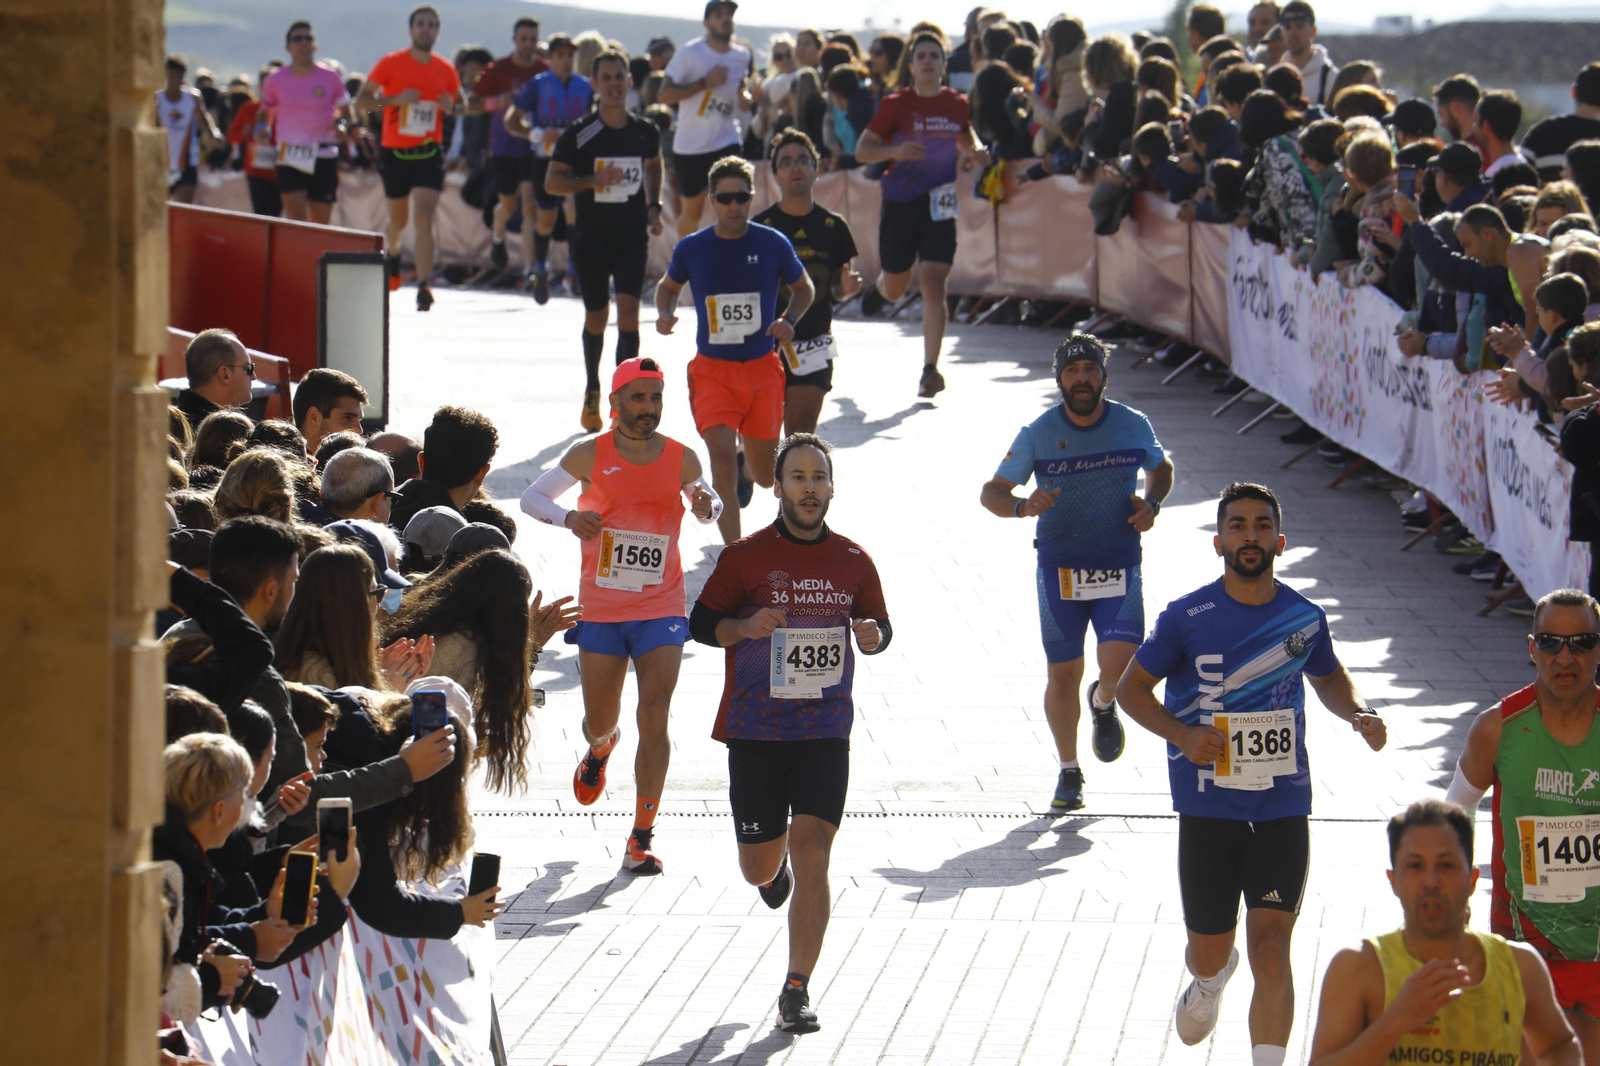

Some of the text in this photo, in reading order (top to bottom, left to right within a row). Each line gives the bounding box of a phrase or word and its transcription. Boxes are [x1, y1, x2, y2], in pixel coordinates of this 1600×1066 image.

[722, 304, 753, 321] 653
[622, 533, 648, 542] IMDECO
[614, 544, 662, 568] 1569
[1073, 568, 1122, 585] 1234
[792, 579, 834, 590] MEDIA
[771, 591, 789, 603] 36
[794, 590, 854, 605] MARATÓN
[1186, 601, 1216, 616] QUEZADA
[786, 644, 841, 669] 4383
[1239, 716, 1273, 724] IMDECO
[1231, 727, 1292, 757] 1368
[1534, 767, 1575, 797] ATARFE
[1535, 791, 1573, 804] Atletismo
[1545, 820, 1583, 829] IMDECO
[1387, 1046, 1455, 1066] AMIGOS
